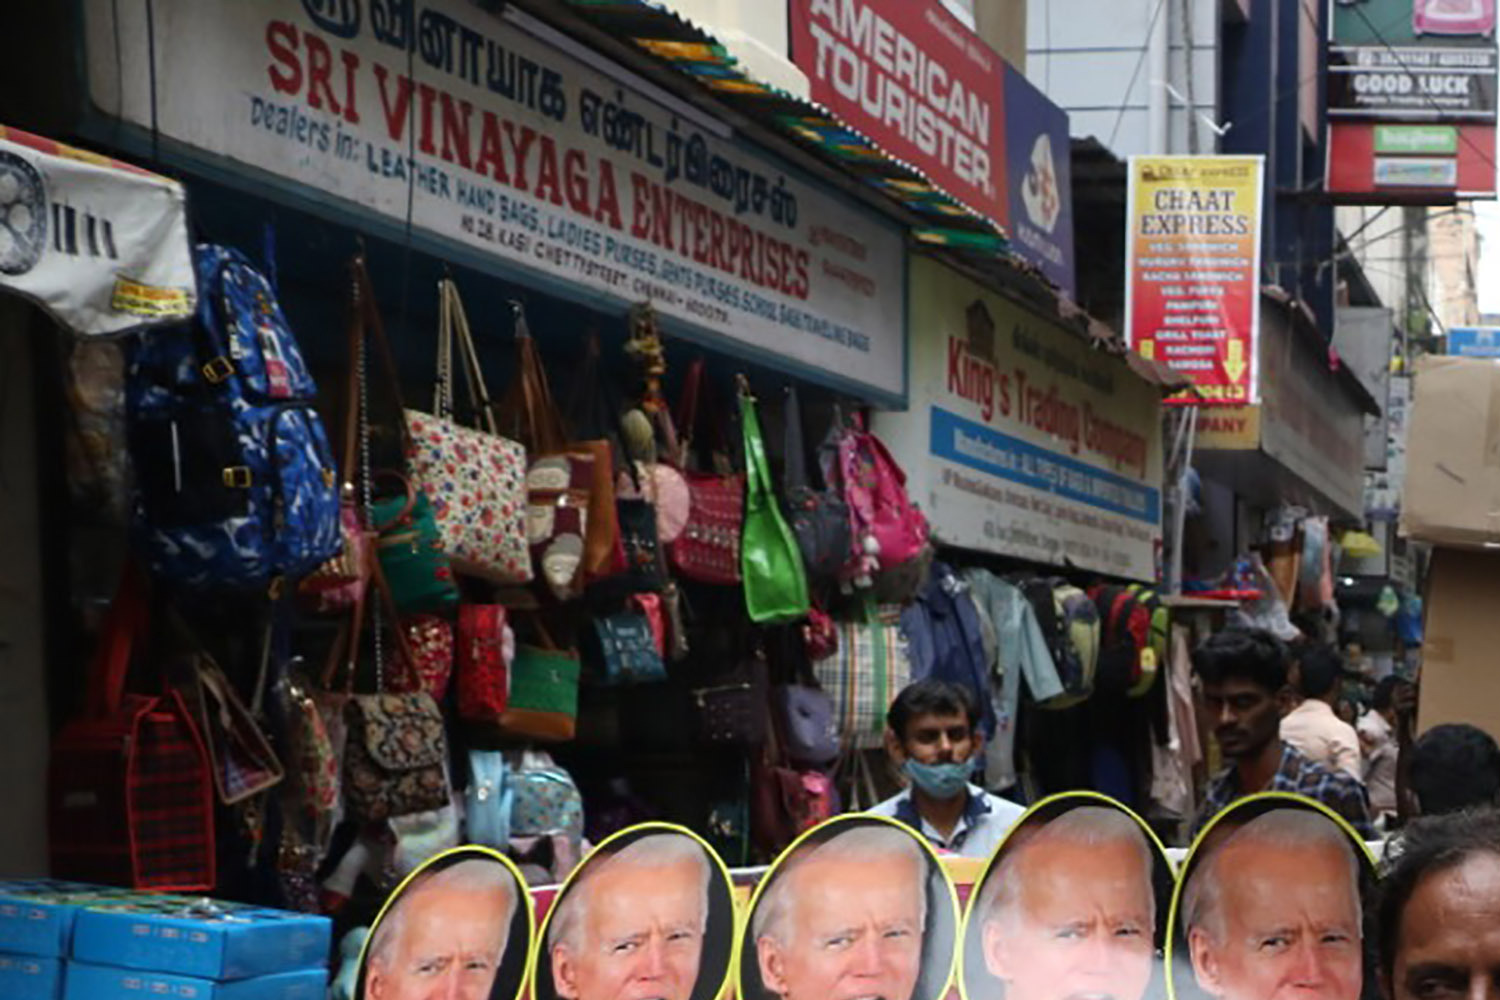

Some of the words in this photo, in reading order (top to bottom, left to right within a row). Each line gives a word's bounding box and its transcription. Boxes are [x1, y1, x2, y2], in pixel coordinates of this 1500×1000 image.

[809, 0, 989, 146] AMERICAN
[809, 22, 992, 197] TOURISTER
[1354, 74, 1413, 93] GOOD
[1416, 75, 1470, 95] LUCK
[251, 96, 331, 152] Dealers
[366, 142, 450, 200] LEATHER
[456, 178, 496, 215] HAND
[547, 213, 601, 256] LADIES
[266, 20, 359, 124] SRI
[373, 63, 623, 231] VINAYAGA
[631, 171, 809, 301] ENTERPRISES
[1141, 214, 1249, 235] EXPRESS
[1155, 189, 1236, 212] CHAAT
[948, 335, 1011, 422] King's
[1014, 368, 1081, 455] Trading
